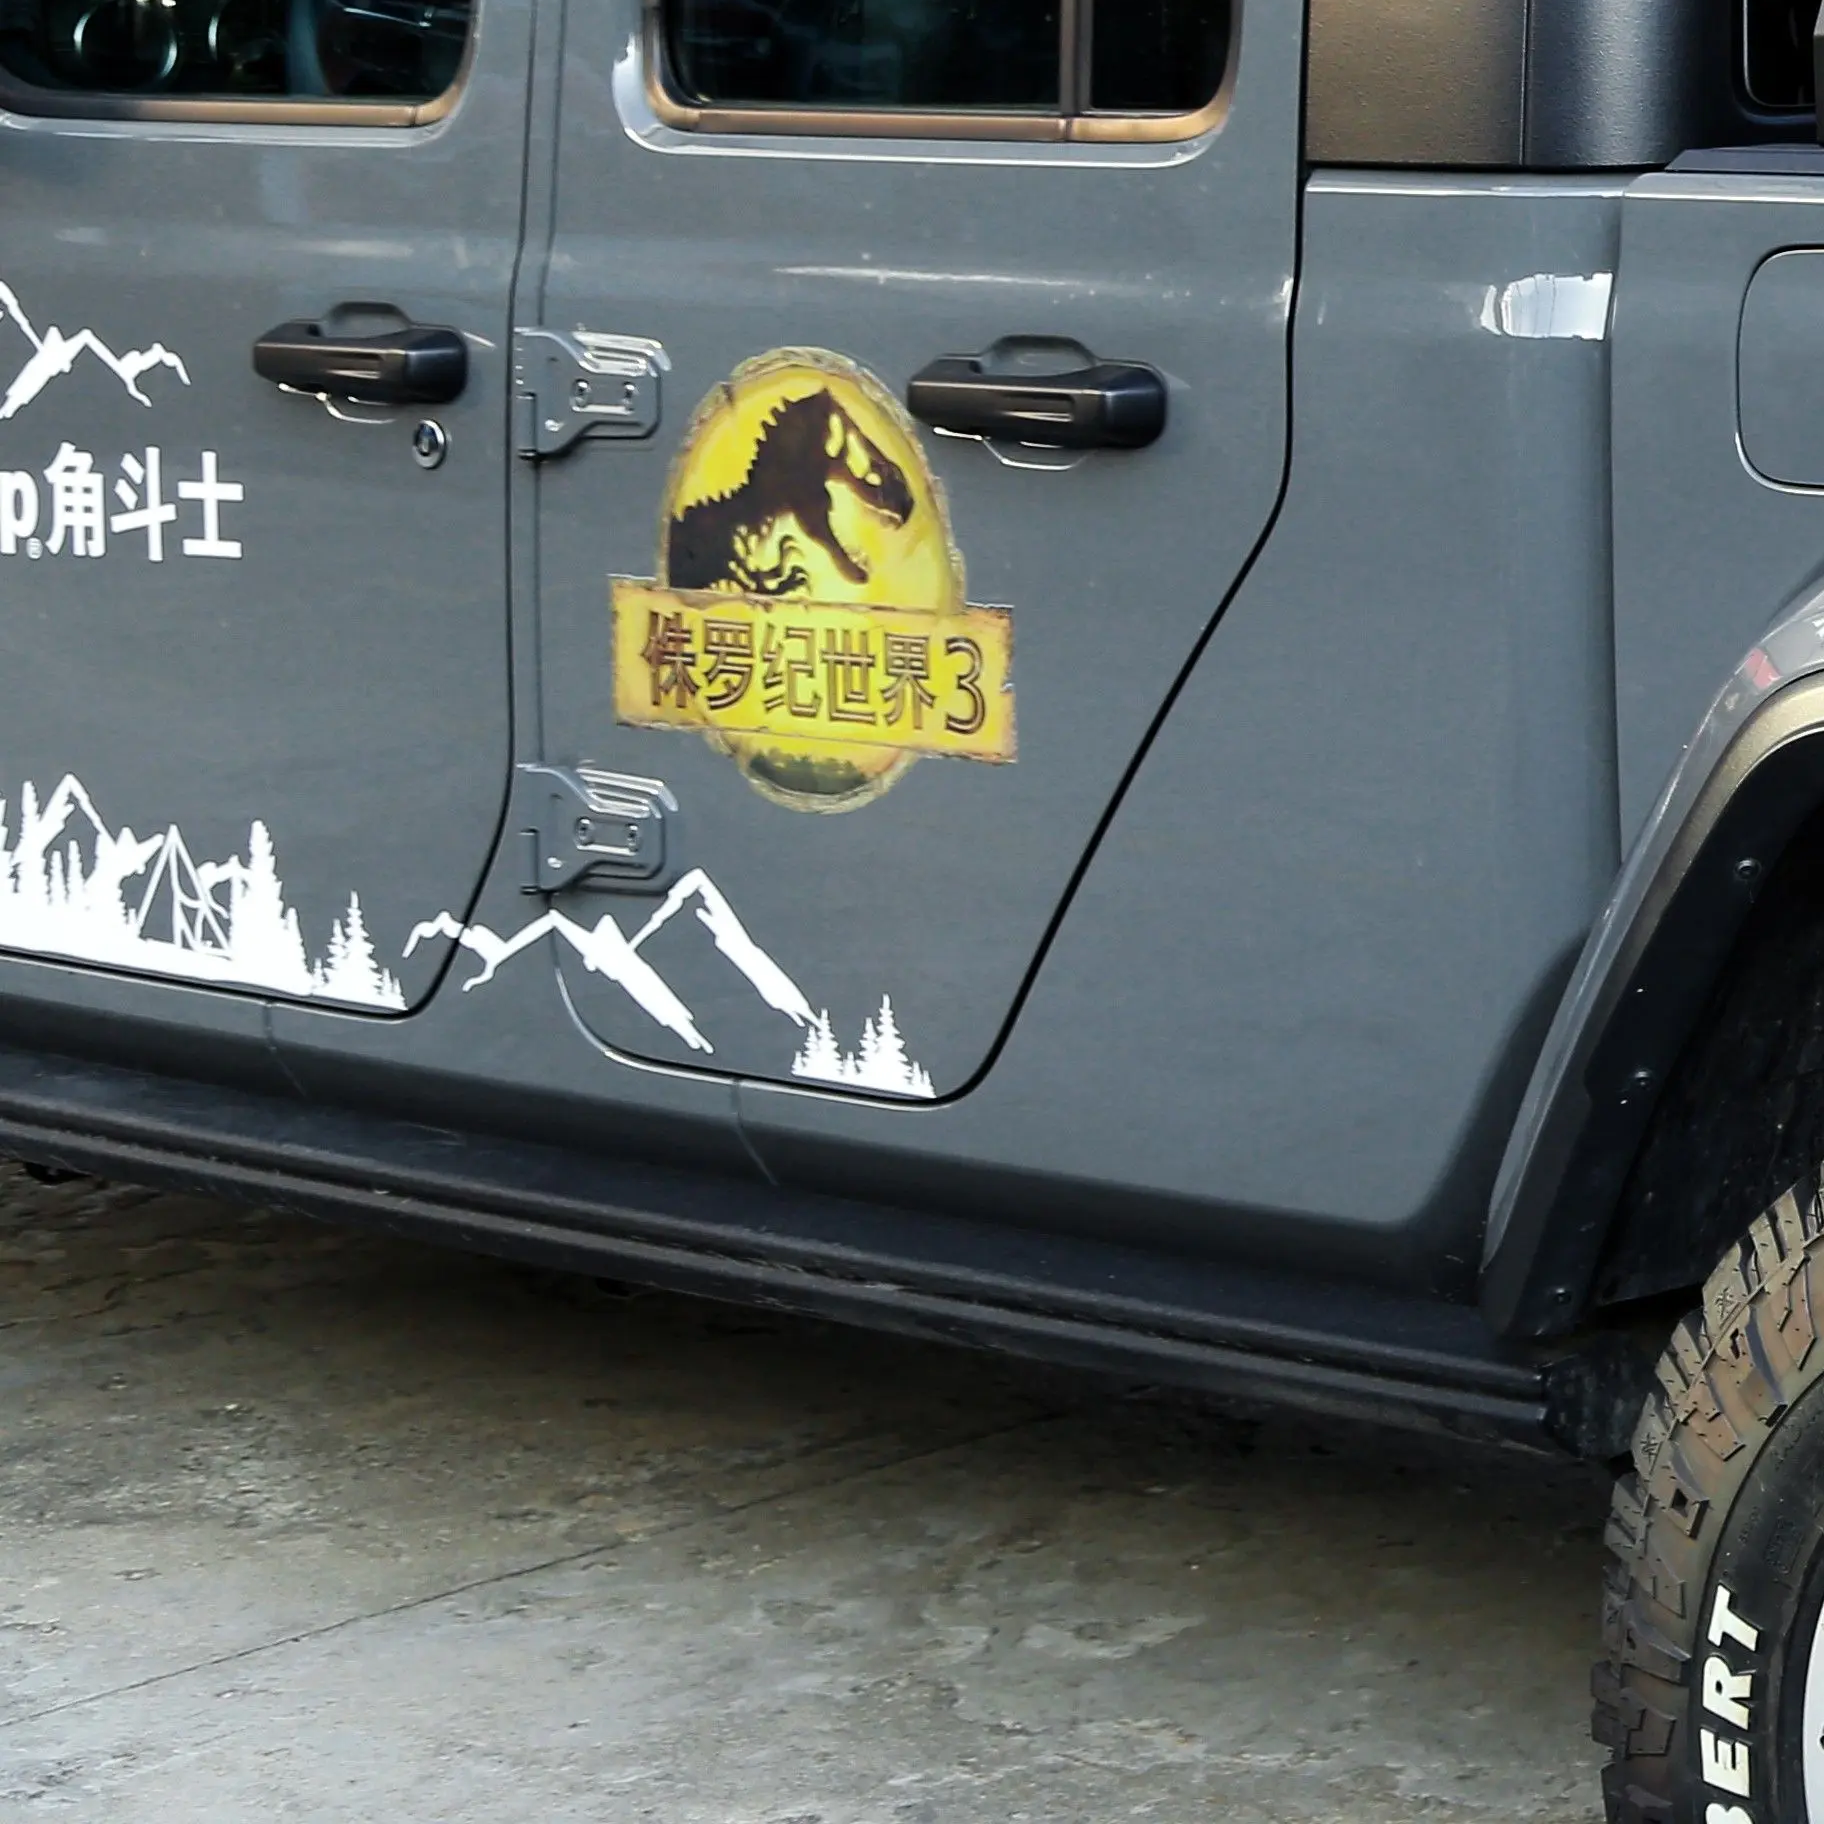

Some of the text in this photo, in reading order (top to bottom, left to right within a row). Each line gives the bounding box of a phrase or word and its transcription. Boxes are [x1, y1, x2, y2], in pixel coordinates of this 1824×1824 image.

[43, 441, 244, 562] 角斗士
[641, 610, 988, 735] 侏罗纪世界3
